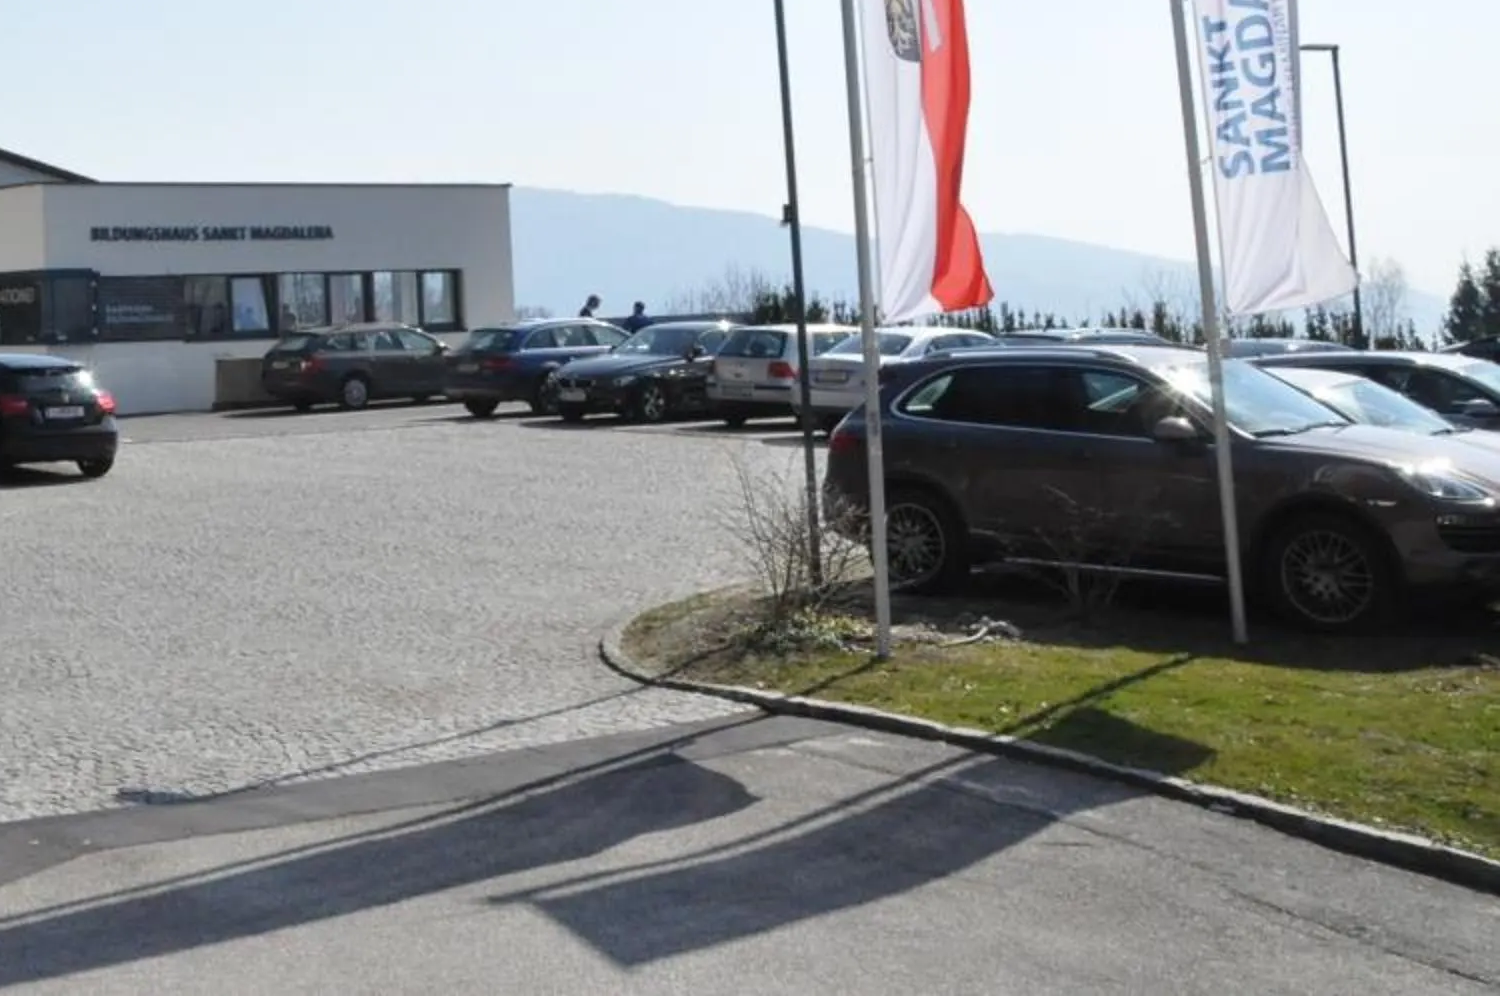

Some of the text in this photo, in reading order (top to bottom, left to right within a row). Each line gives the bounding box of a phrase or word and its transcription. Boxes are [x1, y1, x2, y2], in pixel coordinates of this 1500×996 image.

[1202, 15, 1254, 180] SANKT
[90, 225, 333, 242] BILDUNGSHAUS SANKT MAGDALENA
